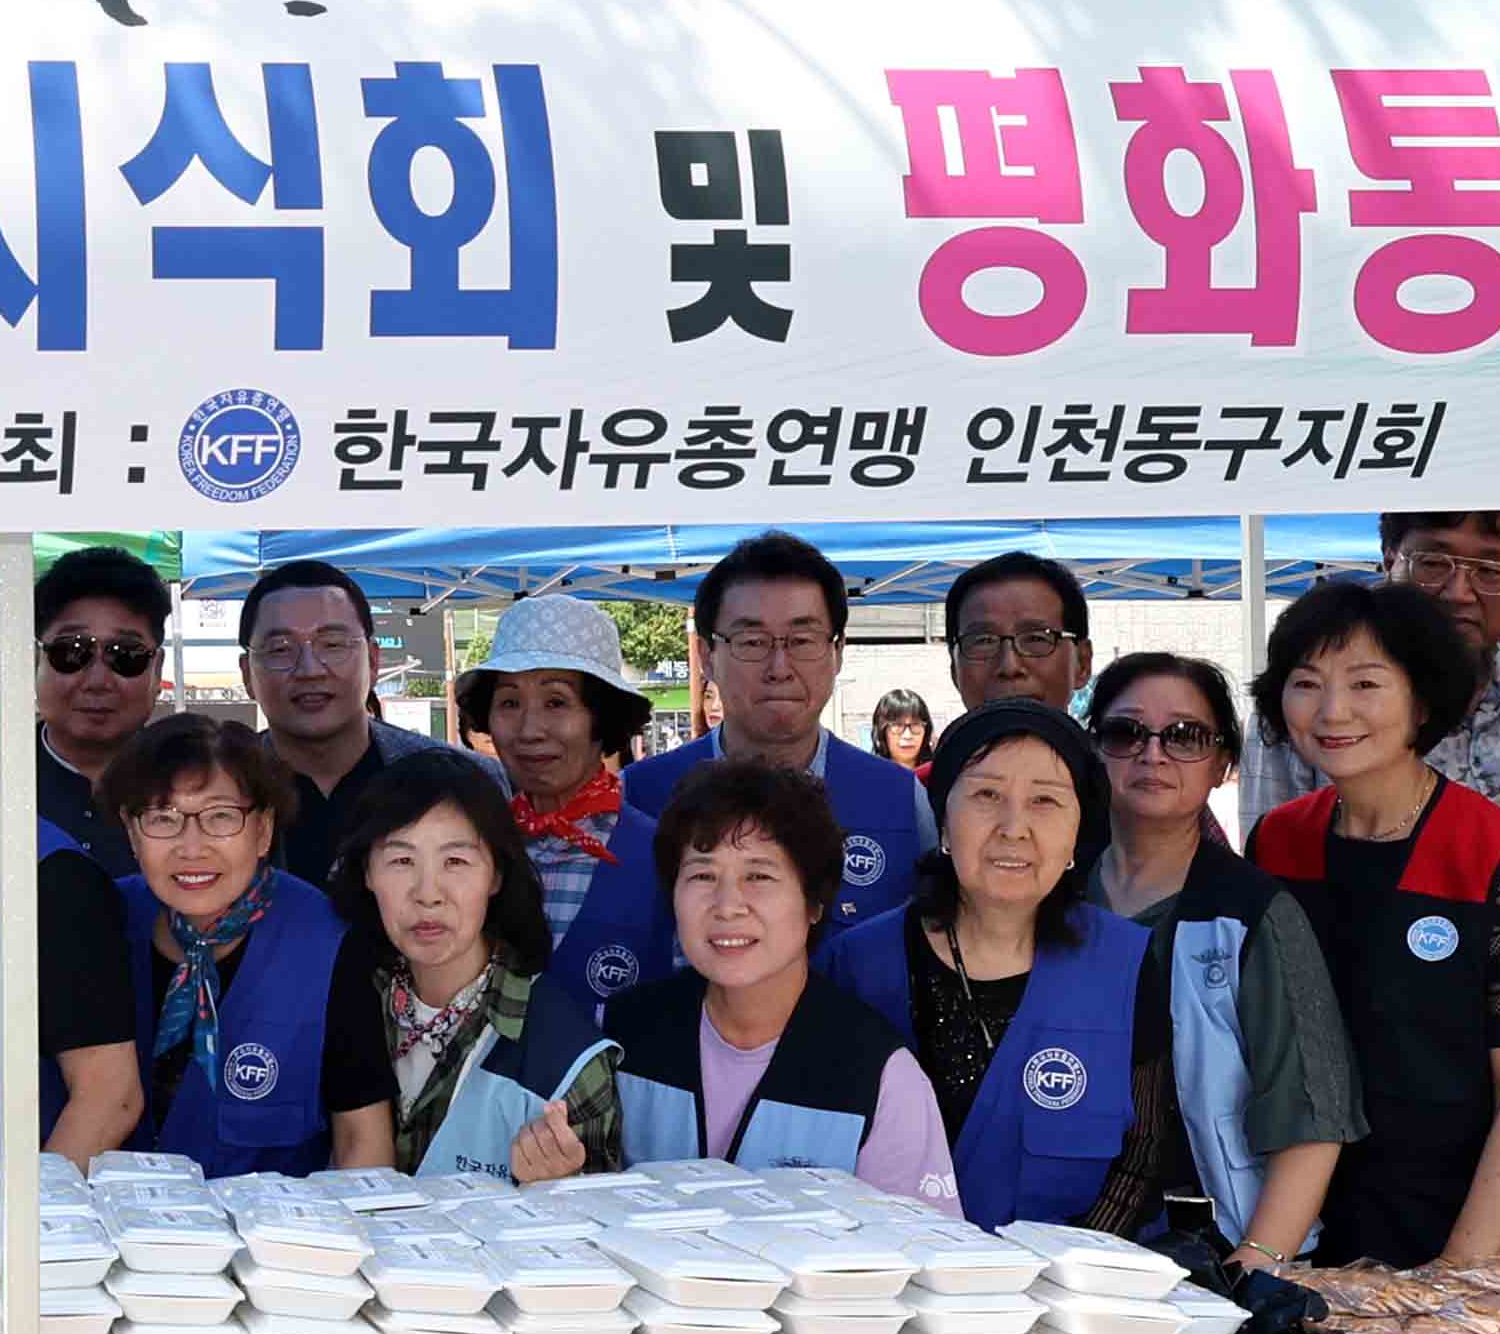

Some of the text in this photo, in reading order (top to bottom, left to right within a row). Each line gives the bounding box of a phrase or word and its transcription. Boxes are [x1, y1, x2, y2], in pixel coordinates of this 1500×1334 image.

[653, 129, 794, 344] 및
[200, 434, 281, 466] KFF
[333, 401, 1448, 492] 한국자유총연맹 인천동구지회
[191, 473, 250, 502] FREEDOM
[844, 853, 876, 870] KFF
[598, 963, 630, 983] KFF
[235, 1062, 267, 1082] KFF
[1037, 1070, 1075, 1090] KFF
